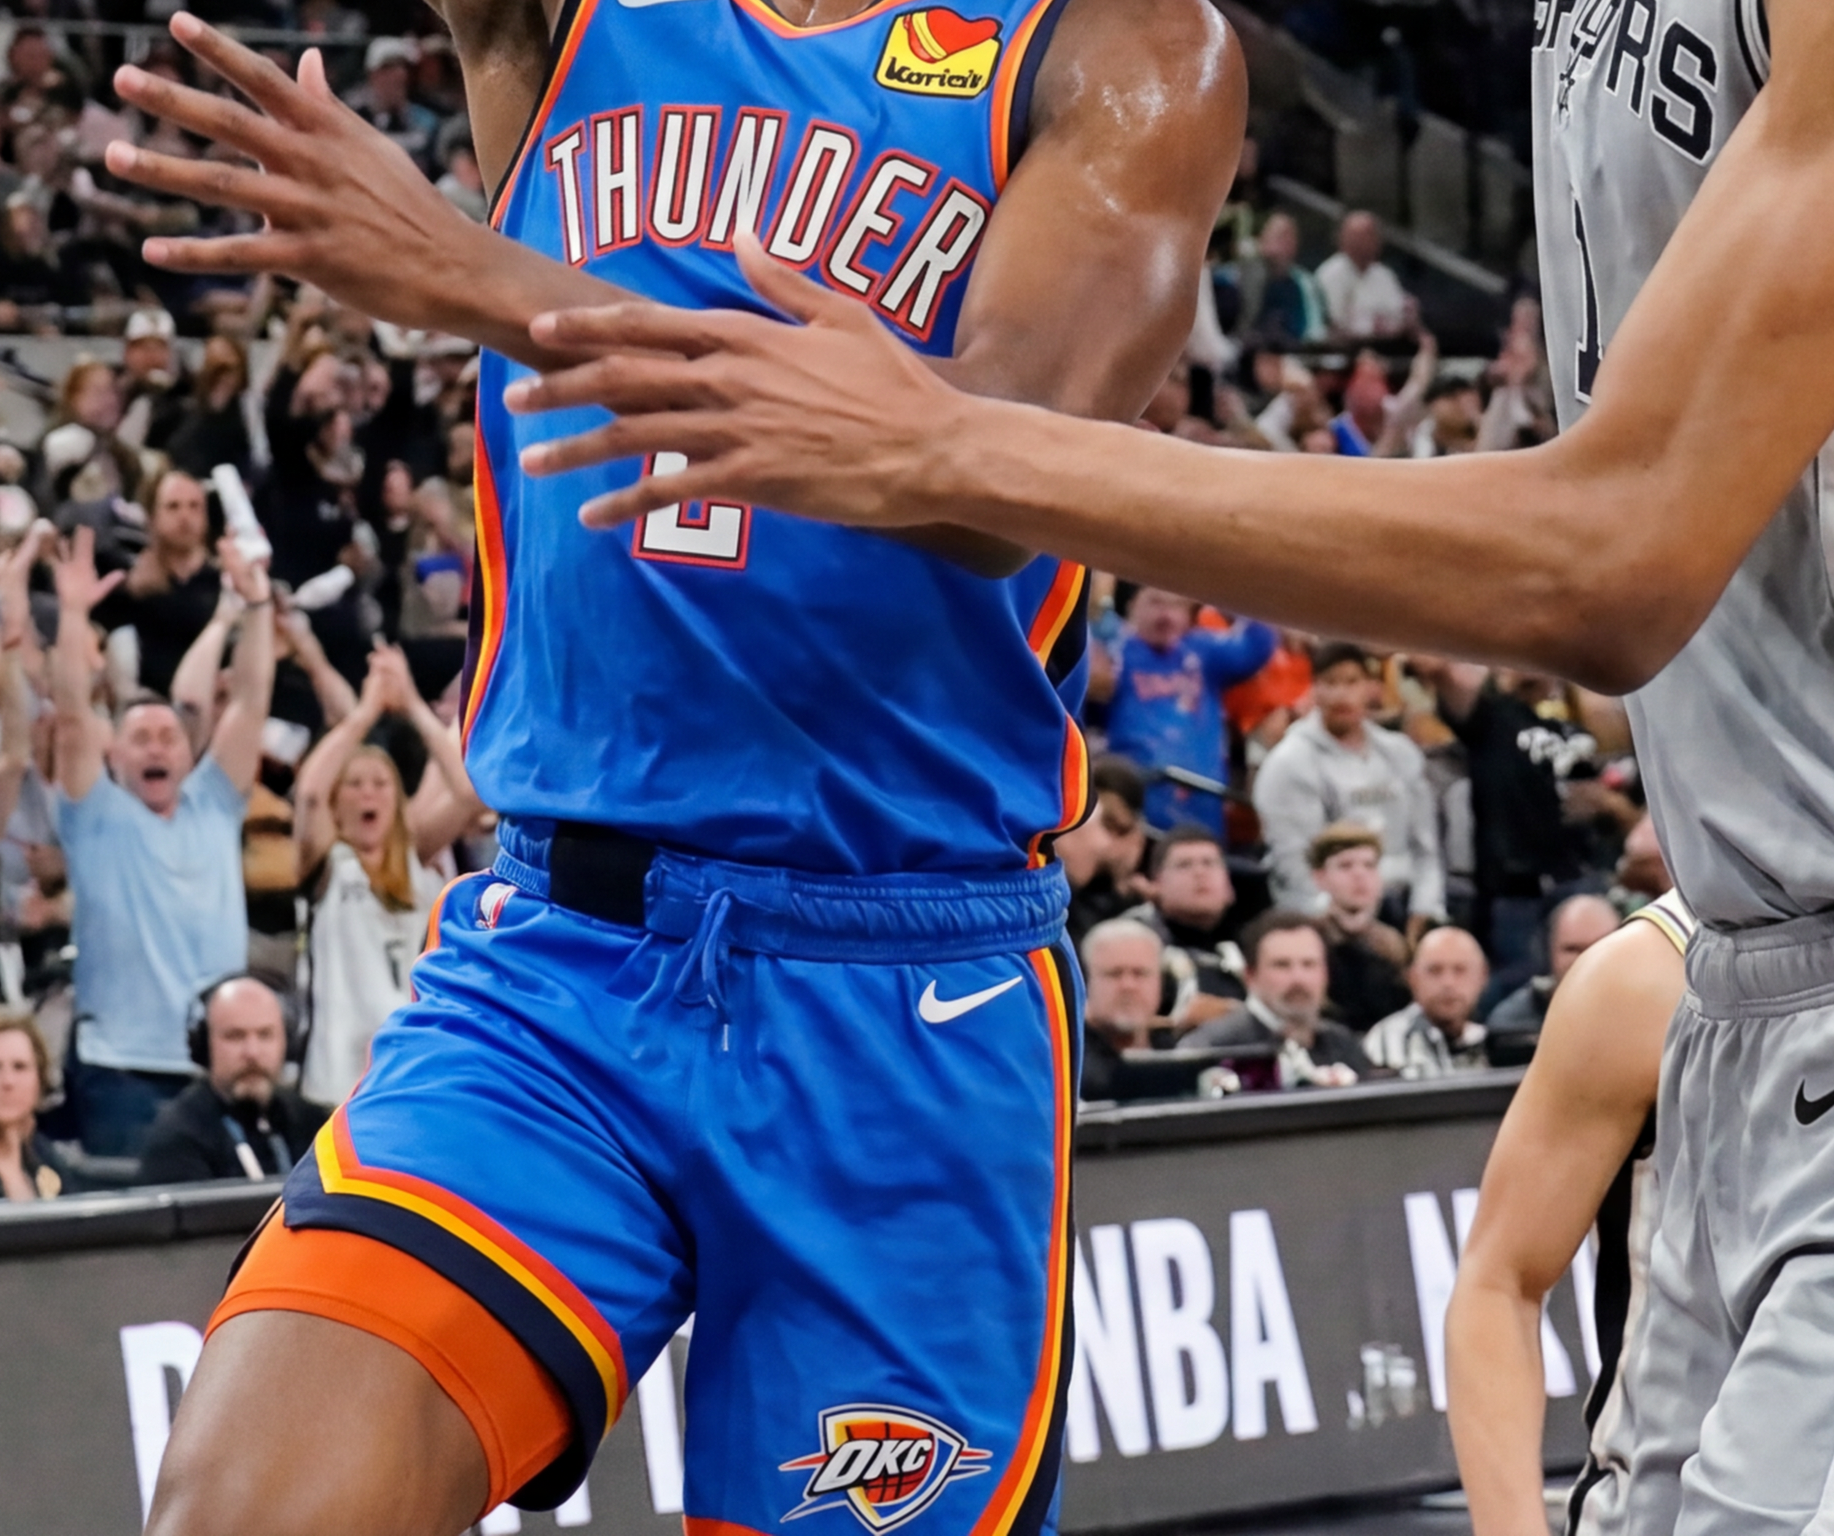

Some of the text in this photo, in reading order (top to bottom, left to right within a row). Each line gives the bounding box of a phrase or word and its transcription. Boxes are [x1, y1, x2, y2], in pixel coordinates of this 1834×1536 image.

[544, 104, 994, 342] THUNDER
[1067, 1208, 1319, 1463] NBA
[812, 1438, 933, 1494] OKC
